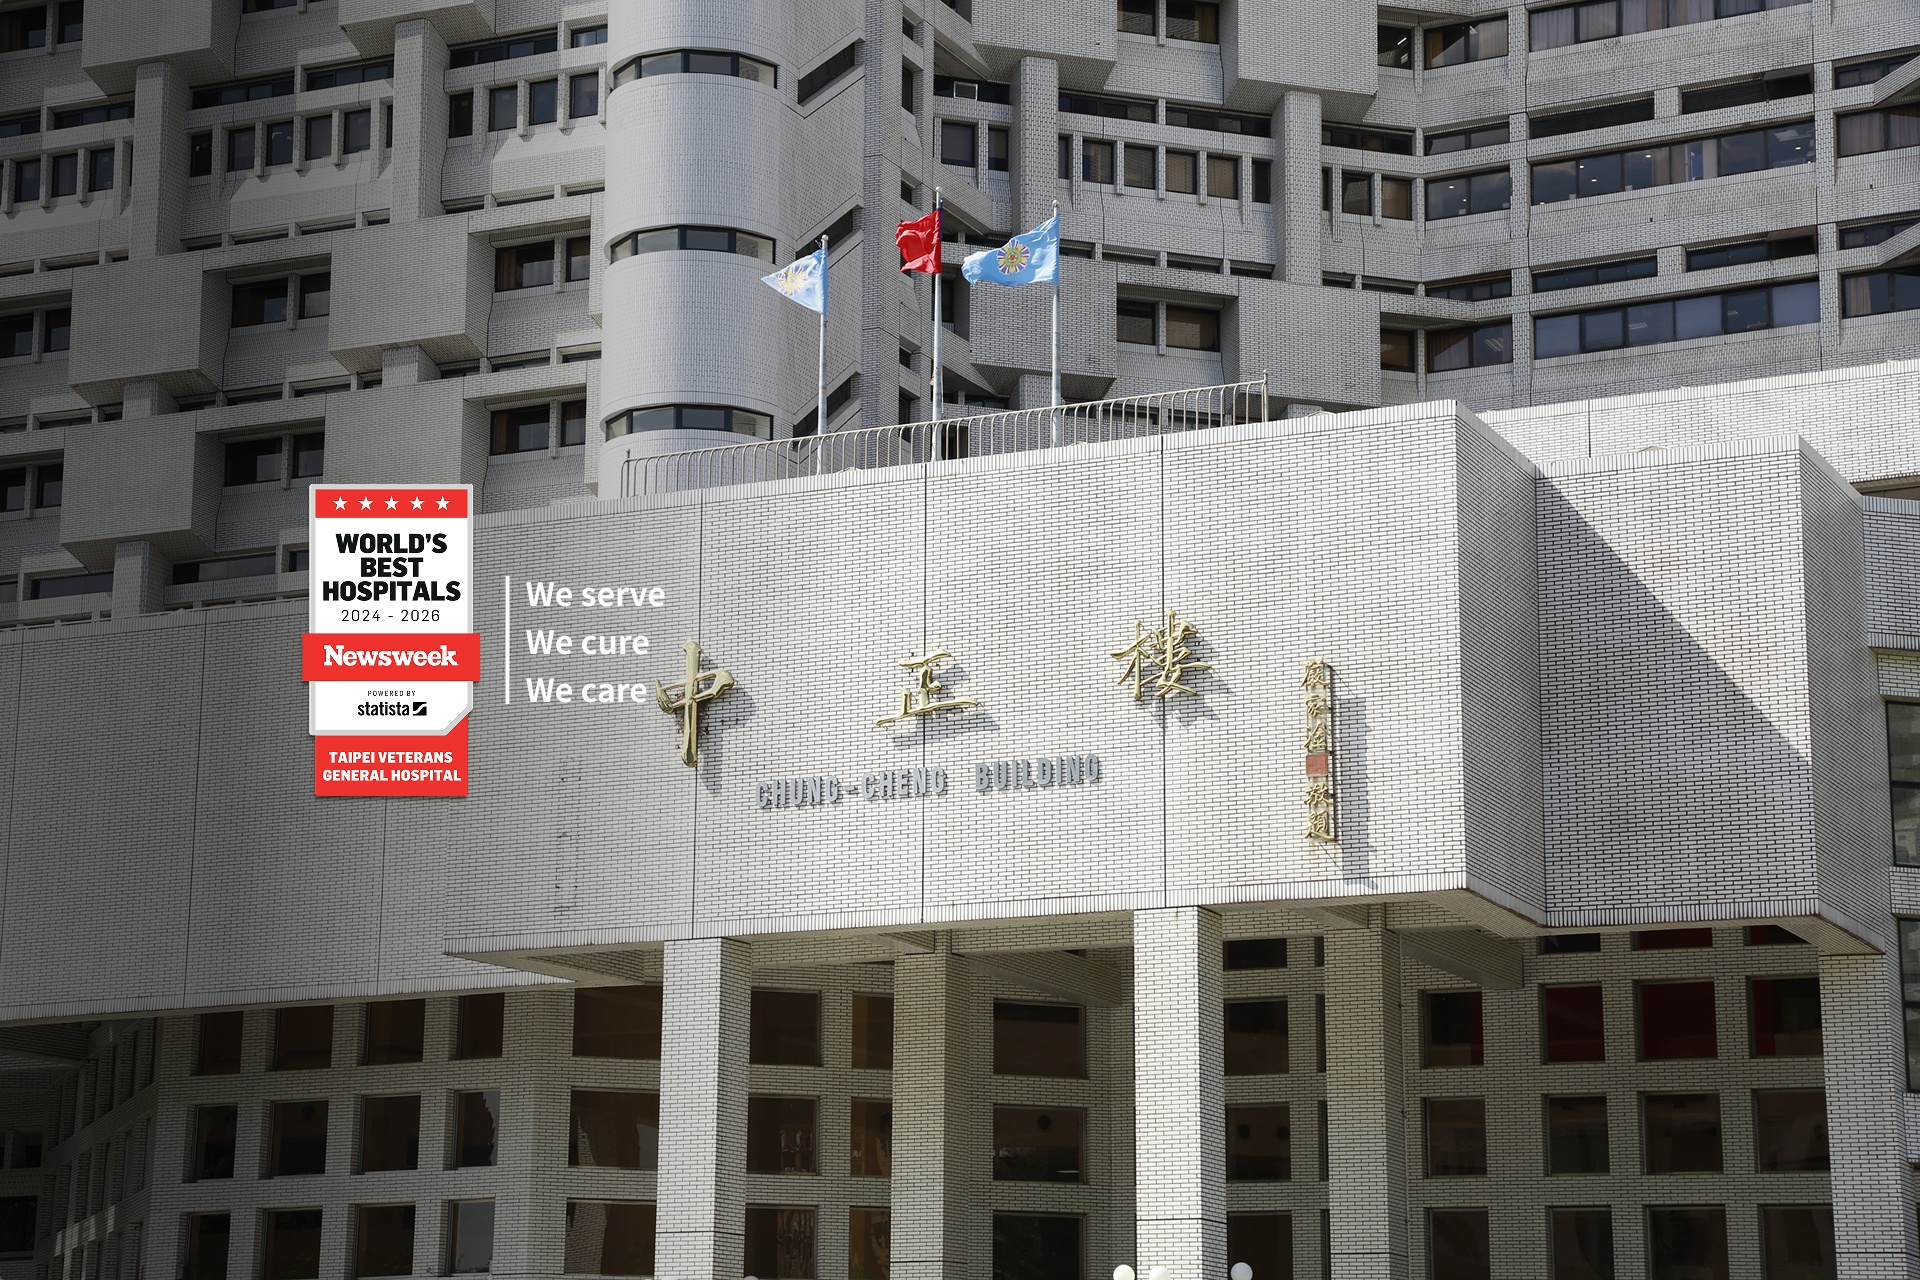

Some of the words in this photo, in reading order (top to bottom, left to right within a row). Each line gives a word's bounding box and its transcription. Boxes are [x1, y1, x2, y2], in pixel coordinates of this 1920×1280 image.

[655, 610, 1211, 768] 中正樓
[755, 766, 947, 808] CHUNG-CHENG
[975, 753, 1100, 791] BUILDING
